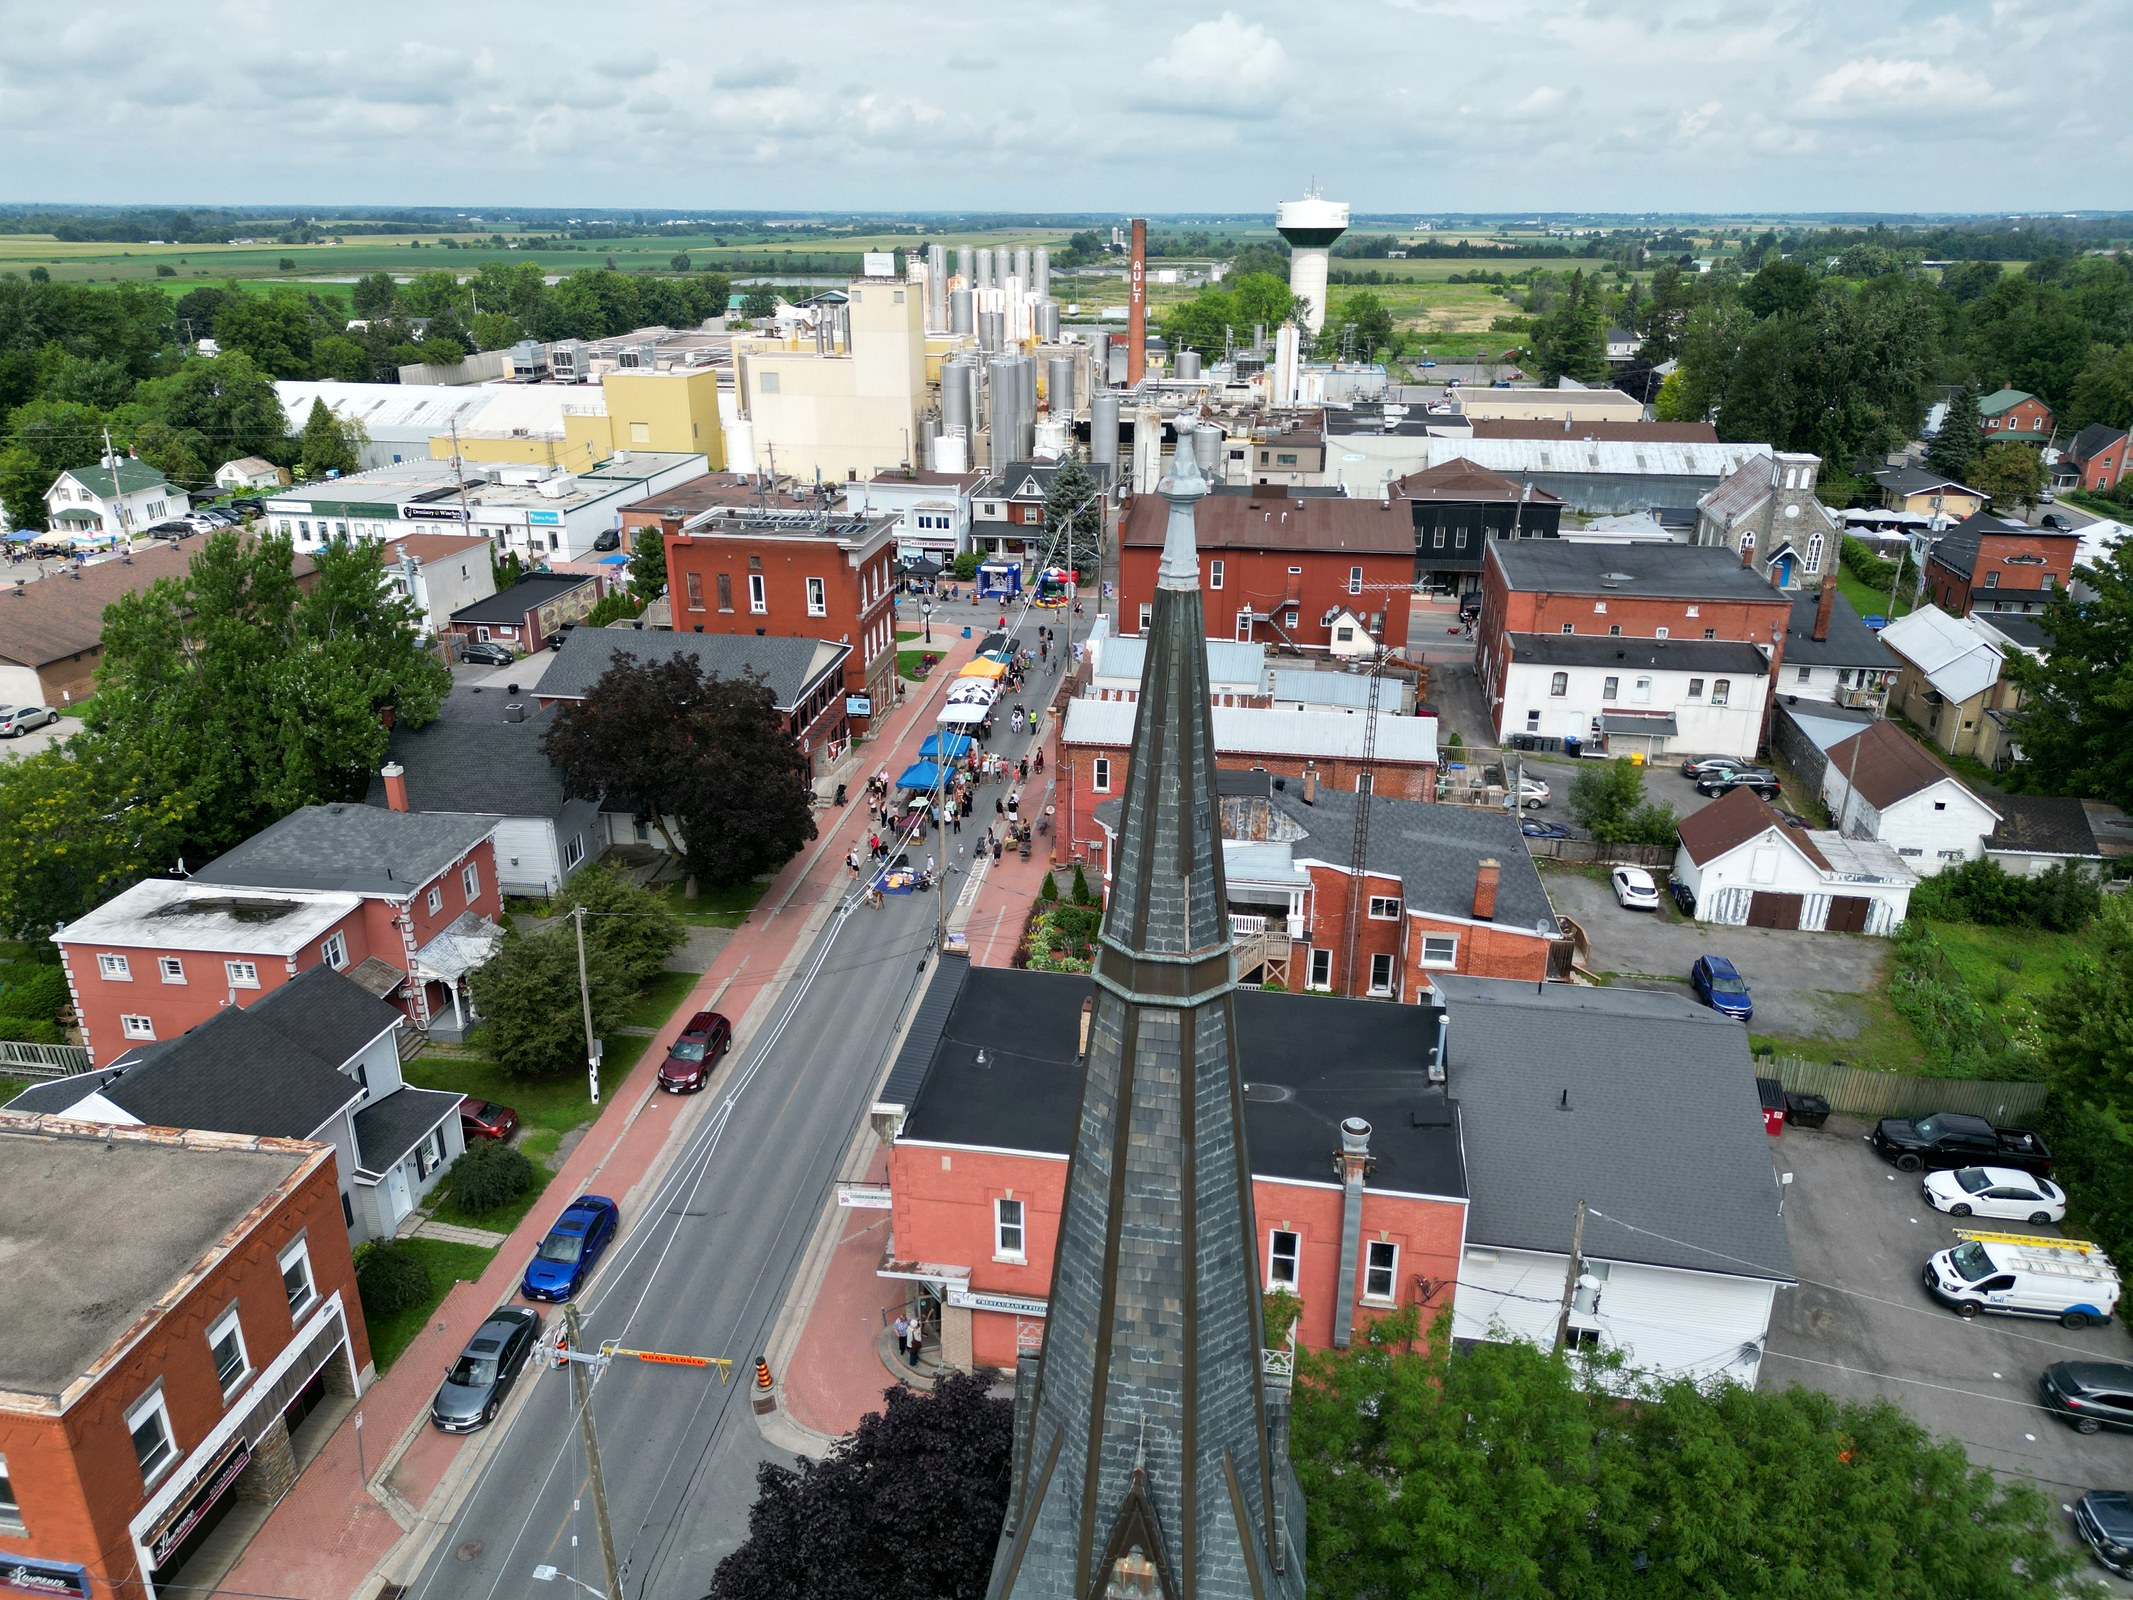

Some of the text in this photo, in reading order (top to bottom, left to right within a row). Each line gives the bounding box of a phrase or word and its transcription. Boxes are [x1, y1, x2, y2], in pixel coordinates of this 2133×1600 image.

[1133, 261, 1141, 302] AULT
[981, 1300, 1022, 1310] RESTAURANT
[156, 1509, 195, 1561] Lawrence
[10, 1565, 67, 1588] Lawrence
